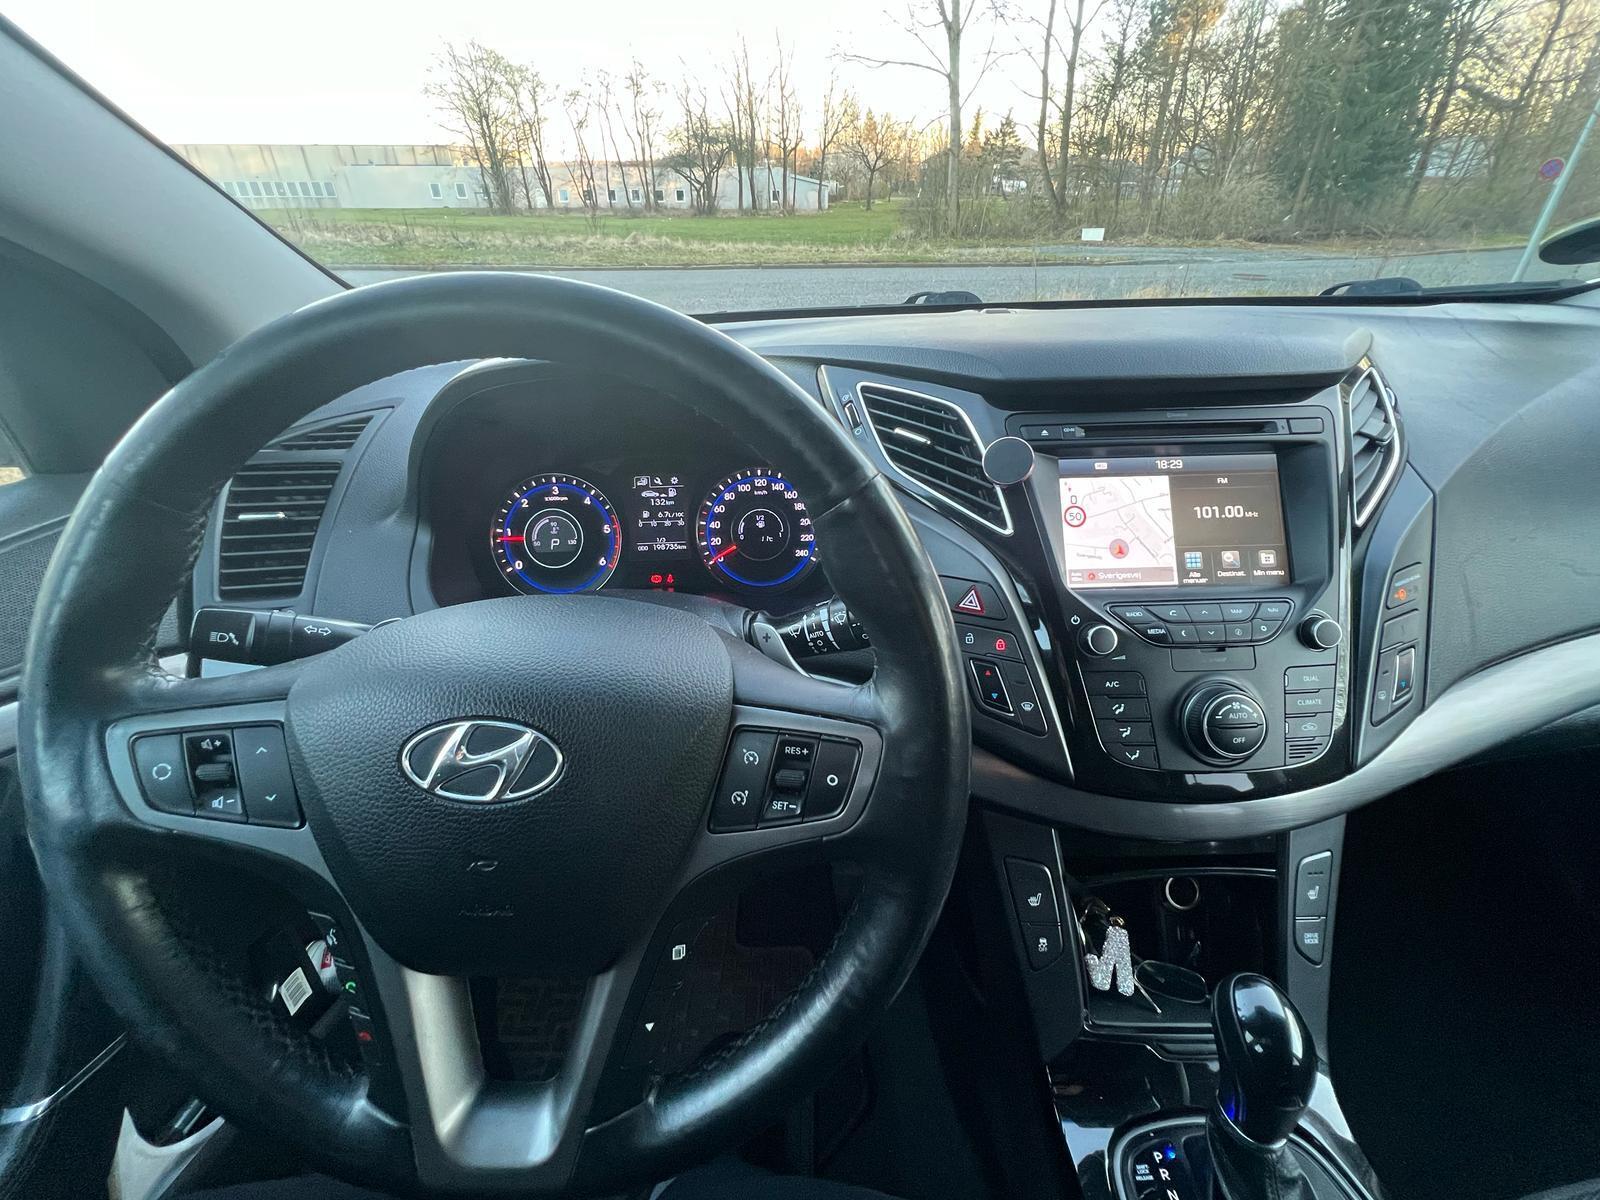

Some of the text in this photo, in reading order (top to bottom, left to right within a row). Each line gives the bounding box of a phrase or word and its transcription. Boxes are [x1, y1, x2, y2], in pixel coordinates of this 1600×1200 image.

[1156, 459, 1183, 469] 18:29
[552, 486, 559, 494] 3
[737, 484, 751, 492] 100
[771, 483, 784, 491] 140
[724, 492, 735, 500] 80
[784, 491, 798, 499] 160
[521, 499, 529, 507] 2
[584, 497, 591, 505] 4
[714, 505, 725, 513] 60
[1194, 505, 1244, 519] 101.00
[1069, 512, 1082, 521] 50
[603, 524, 611, 534] 5
[709, 521, 720, 529] 40
[506, 528, 512, 536] 1
[801, 534, 814, 542] 220
[551, 539, 560, 550] P
[795, 549, 809, 557] 240
[515, 560, 523, 570] 0
[599, 557, 606, 566] 6
[809, 630, 824, 639] AUTO
[1105, 680, 1120, 688] A/C
[1153, 1151, 1163, 1163] P
[1159, 1168, 1171, 1180] R
[1166, 1189, 1180, 1200] N
